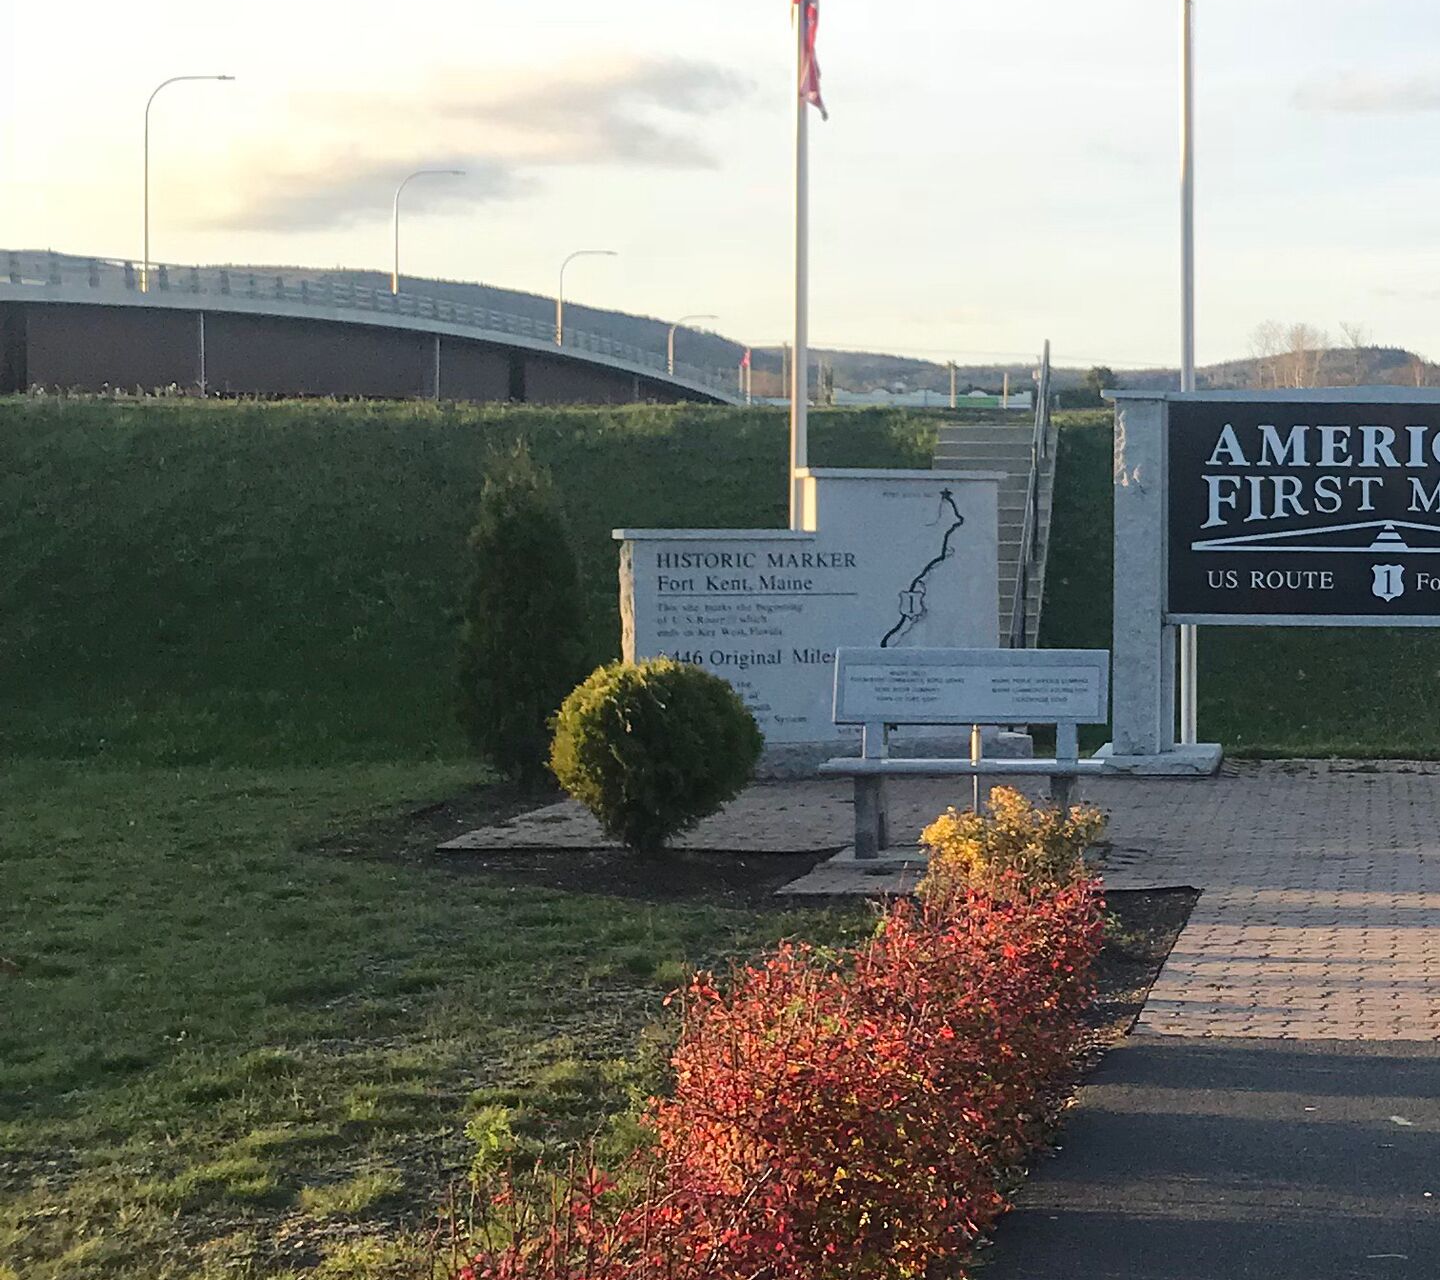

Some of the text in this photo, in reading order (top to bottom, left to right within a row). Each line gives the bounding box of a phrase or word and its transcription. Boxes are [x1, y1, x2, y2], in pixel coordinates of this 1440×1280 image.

[1200, 473, 1384, 529] FIRST
[656, 551, 858, 570] HISTORIC MARKER
[657, 574, 815, 593] Fort Kent, Maine
[1206, 569, 1335, 590] US ROUTE
[1383, 569, 1395, 595] 1
[710, 649, 783, 670] Original
